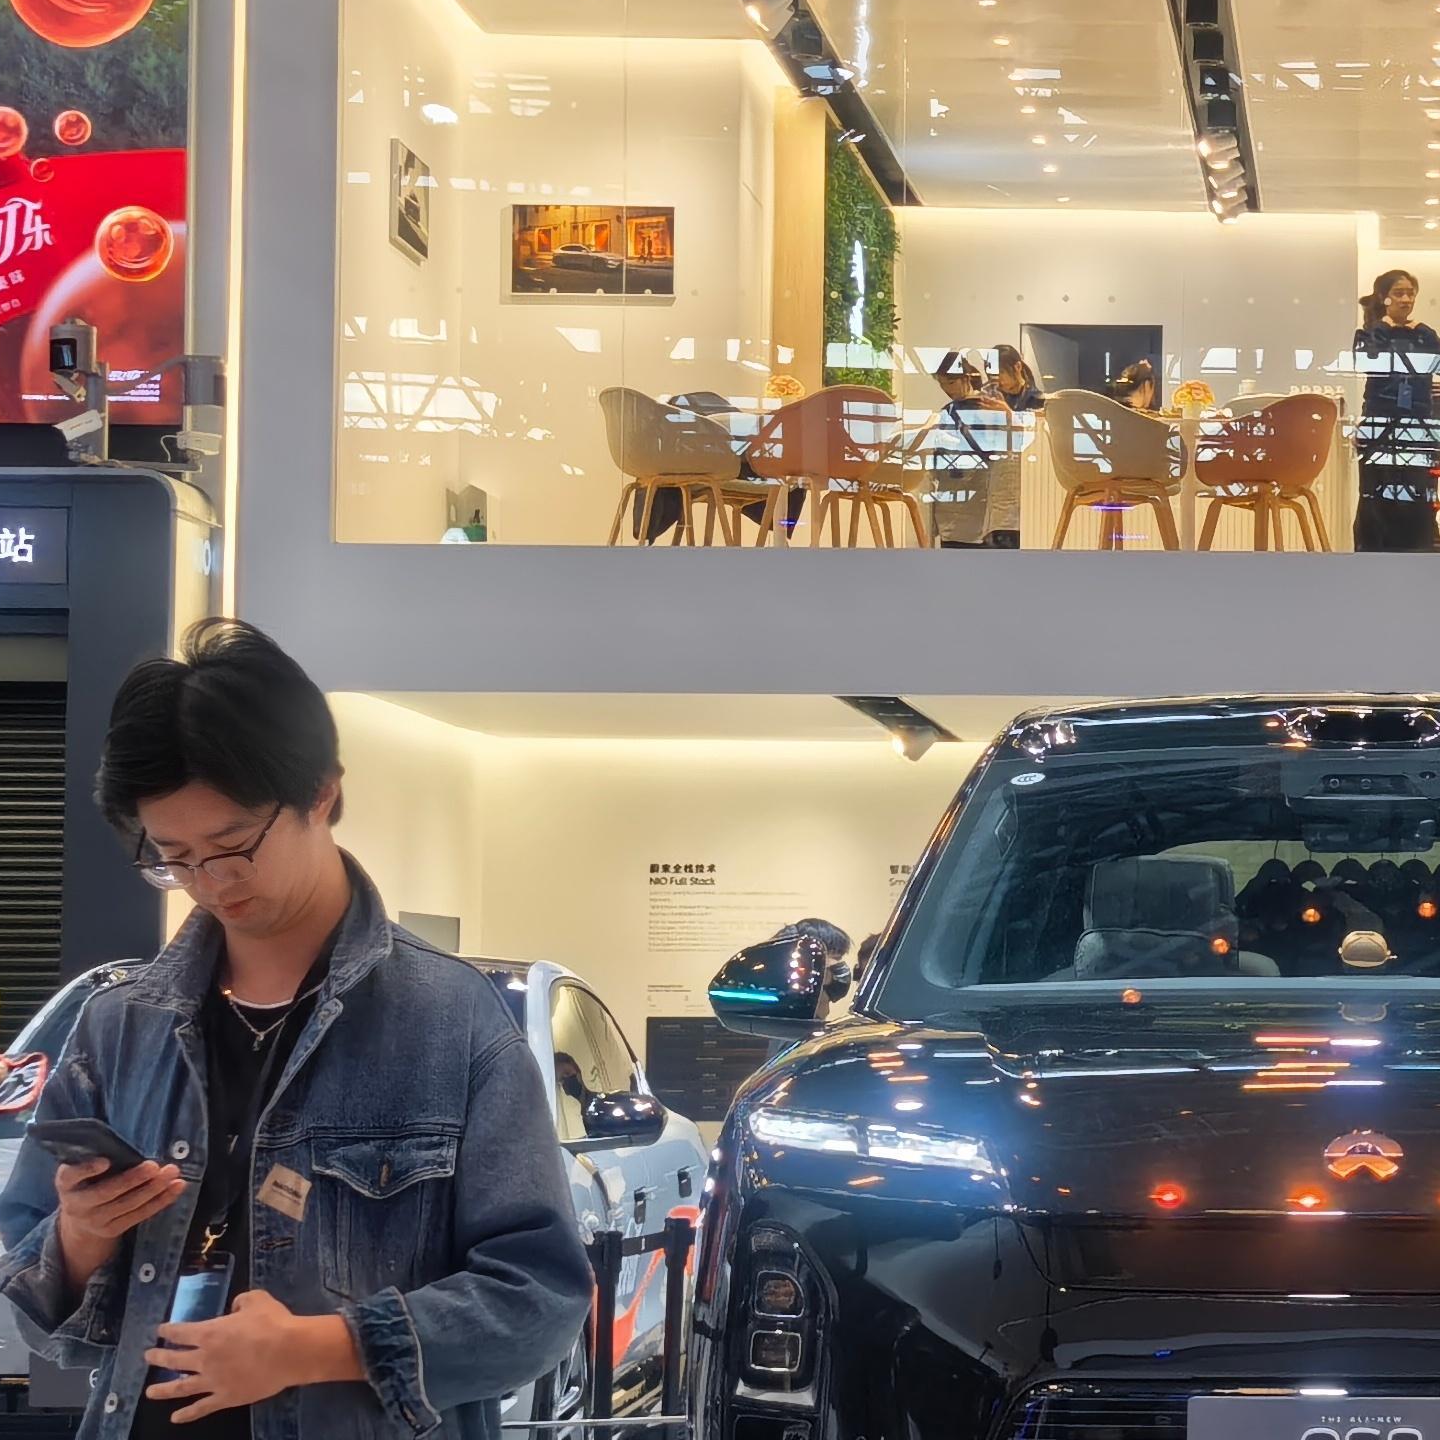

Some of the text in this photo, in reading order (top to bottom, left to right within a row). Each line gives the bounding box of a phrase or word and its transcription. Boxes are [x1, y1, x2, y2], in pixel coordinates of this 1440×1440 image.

[649, 876, 716, 886] NIO Full Stack
